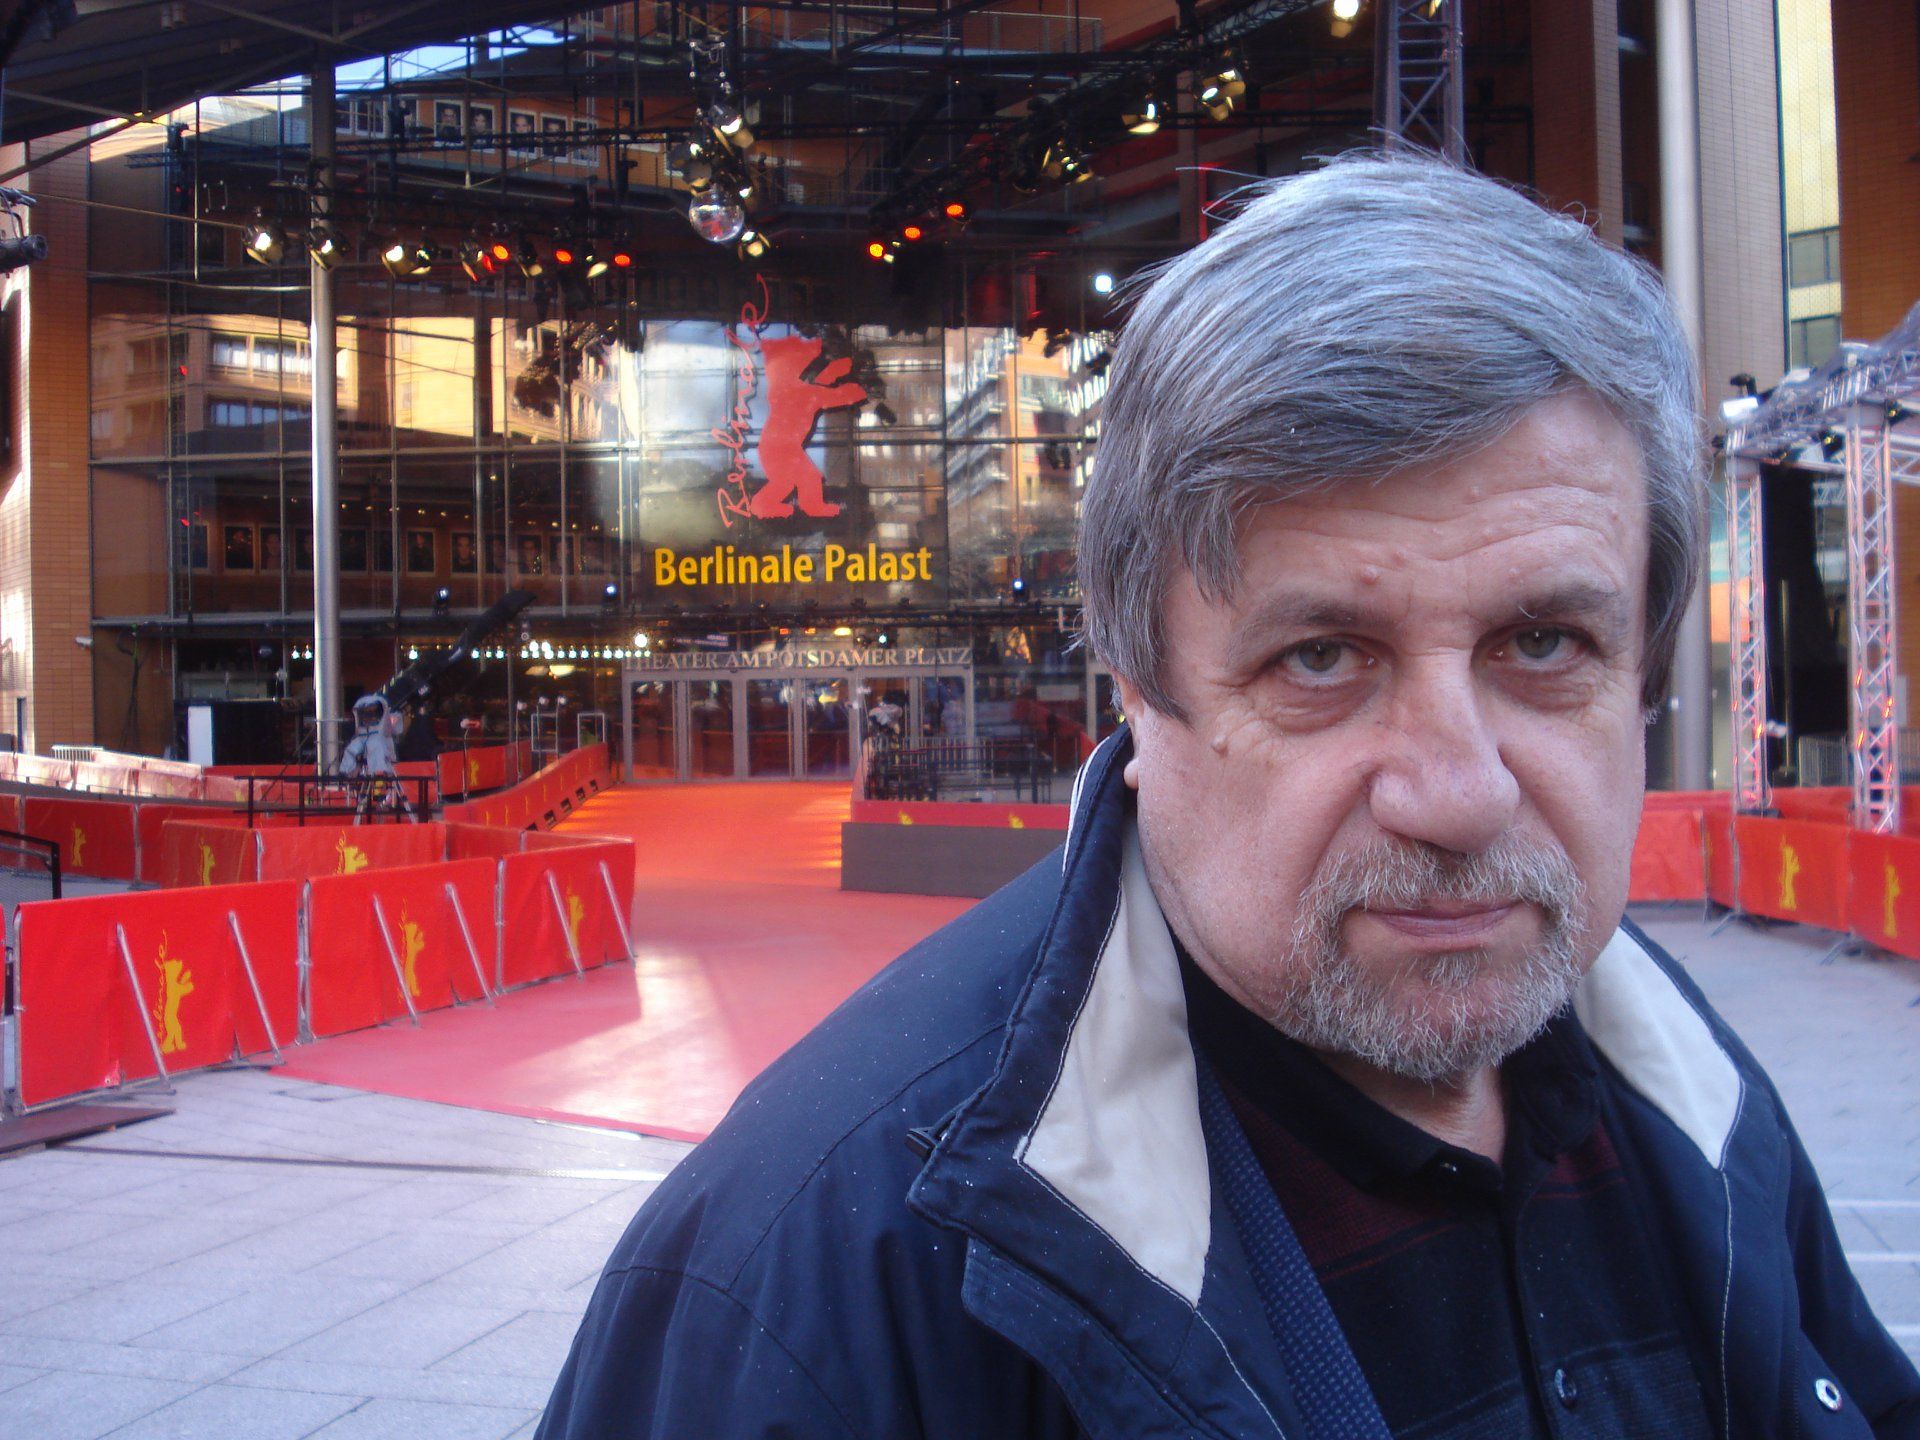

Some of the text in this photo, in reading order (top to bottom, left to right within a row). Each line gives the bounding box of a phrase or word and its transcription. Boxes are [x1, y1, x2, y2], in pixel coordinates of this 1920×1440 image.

[654, 542, 933, 587] Berlinale Palast
[724, 650, 760, 669] AM
[765, 648, 899, 670] POTSDAMER
[904, 647, 973, 665] PLATZ
